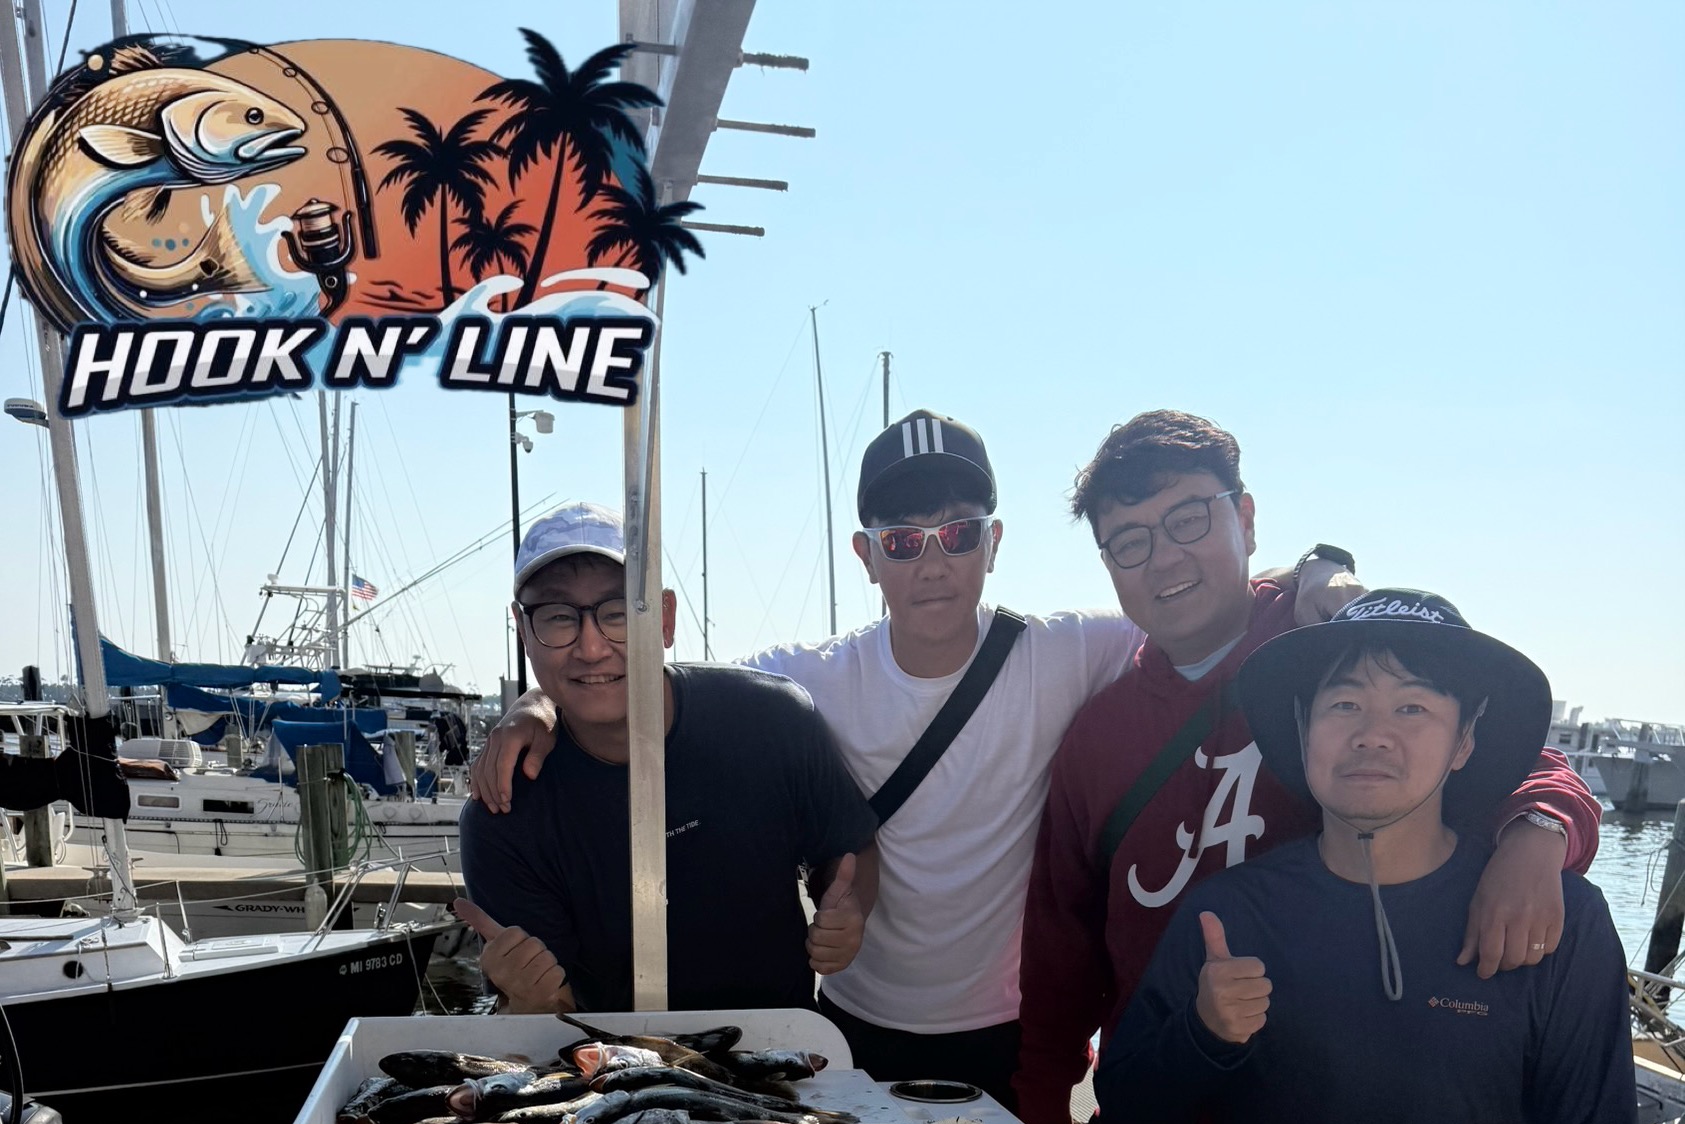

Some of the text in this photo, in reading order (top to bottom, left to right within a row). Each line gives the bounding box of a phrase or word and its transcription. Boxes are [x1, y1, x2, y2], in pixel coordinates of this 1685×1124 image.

[1346, 597, 1444, 624] Titleist
[1127, 740, 1265, 908] A
[235, 904, 305, 914] GRADY-WH
[350, 953, 403, 974] MI 9783 CD
[1440, 998, 1489, 1011] Columbia
